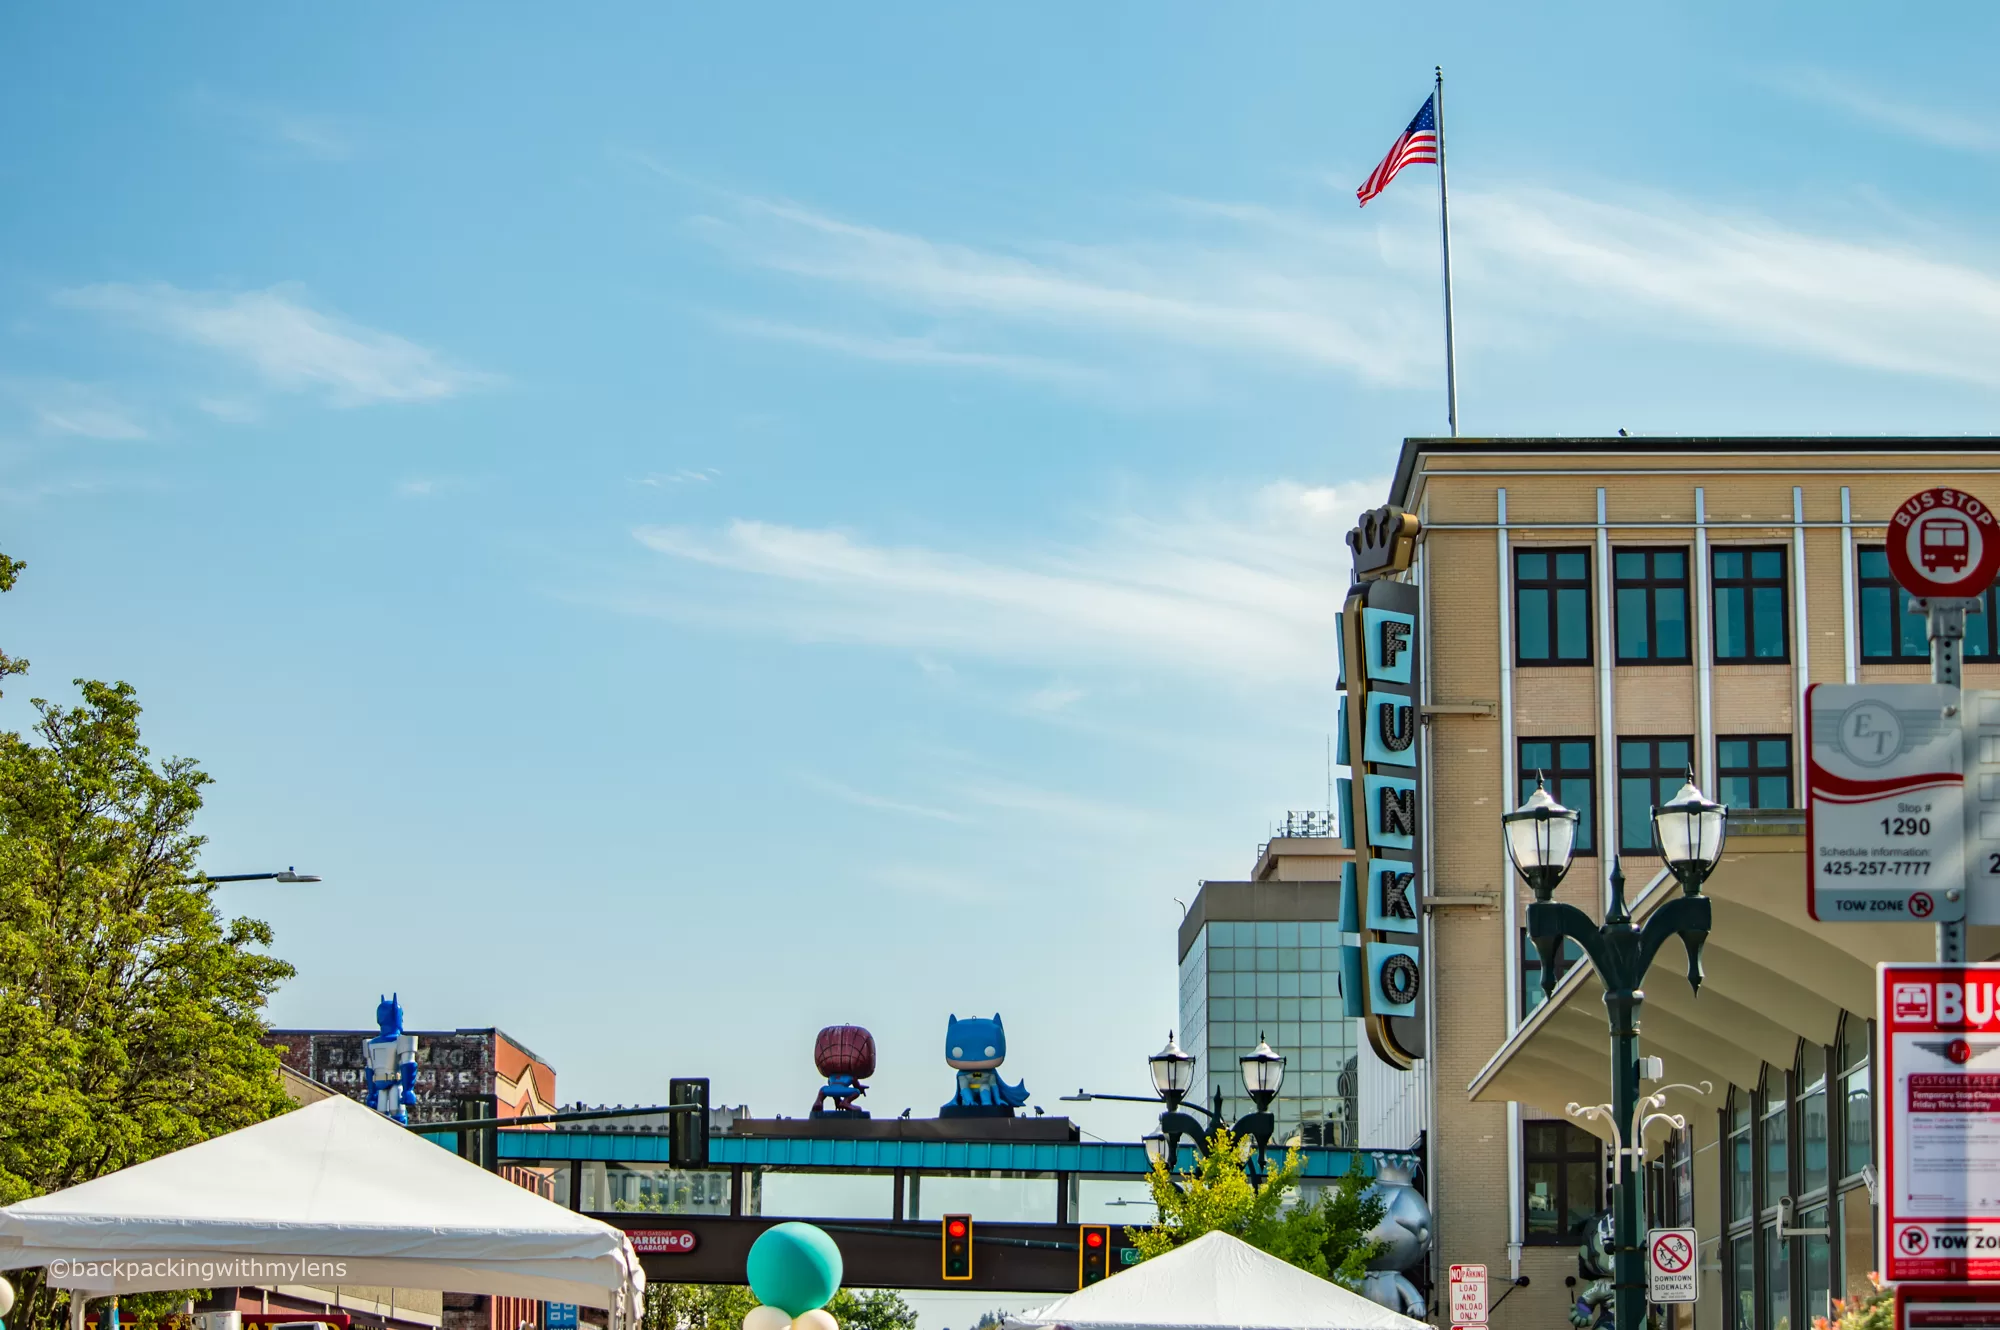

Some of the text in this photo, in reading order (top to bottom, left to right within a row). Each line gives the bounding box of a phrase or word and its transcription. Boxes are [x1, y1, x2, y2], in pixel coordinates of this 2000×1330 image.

[1895, 490, 1992, 527] BUS STOP
[1852, 713, 1893, 756] ET
[1379, 620, 1420, 1005] FUNKO
[1897, 802, 1922, 813] Stop
[1880, 817, 1931, 836] 1290
[1819, 847, 1931, 857] Schedule information:
[1823, 861, 1931, 876] 425-257-7777
[1835, 900, 1903, 911] TOW ZONE
[1911, 1076, 1968, 1085] CUSTOMER
[1912, 1090, 1954, 1100] Temporary
[1955, 1090, 1973, 1100] Stop
[1912, 1100, 1991, 1110] Friday Thru Saturday
[628, 1236, 678, 1245] PARKING
[1932, 1236, 1968, 1249] TOW
[1451, 1269, 1484, 1280] NO PARKING
[1455, 1303, 1483, 1311] UNLOAD
[1460, 1312, 1478, 1320] ONLY
